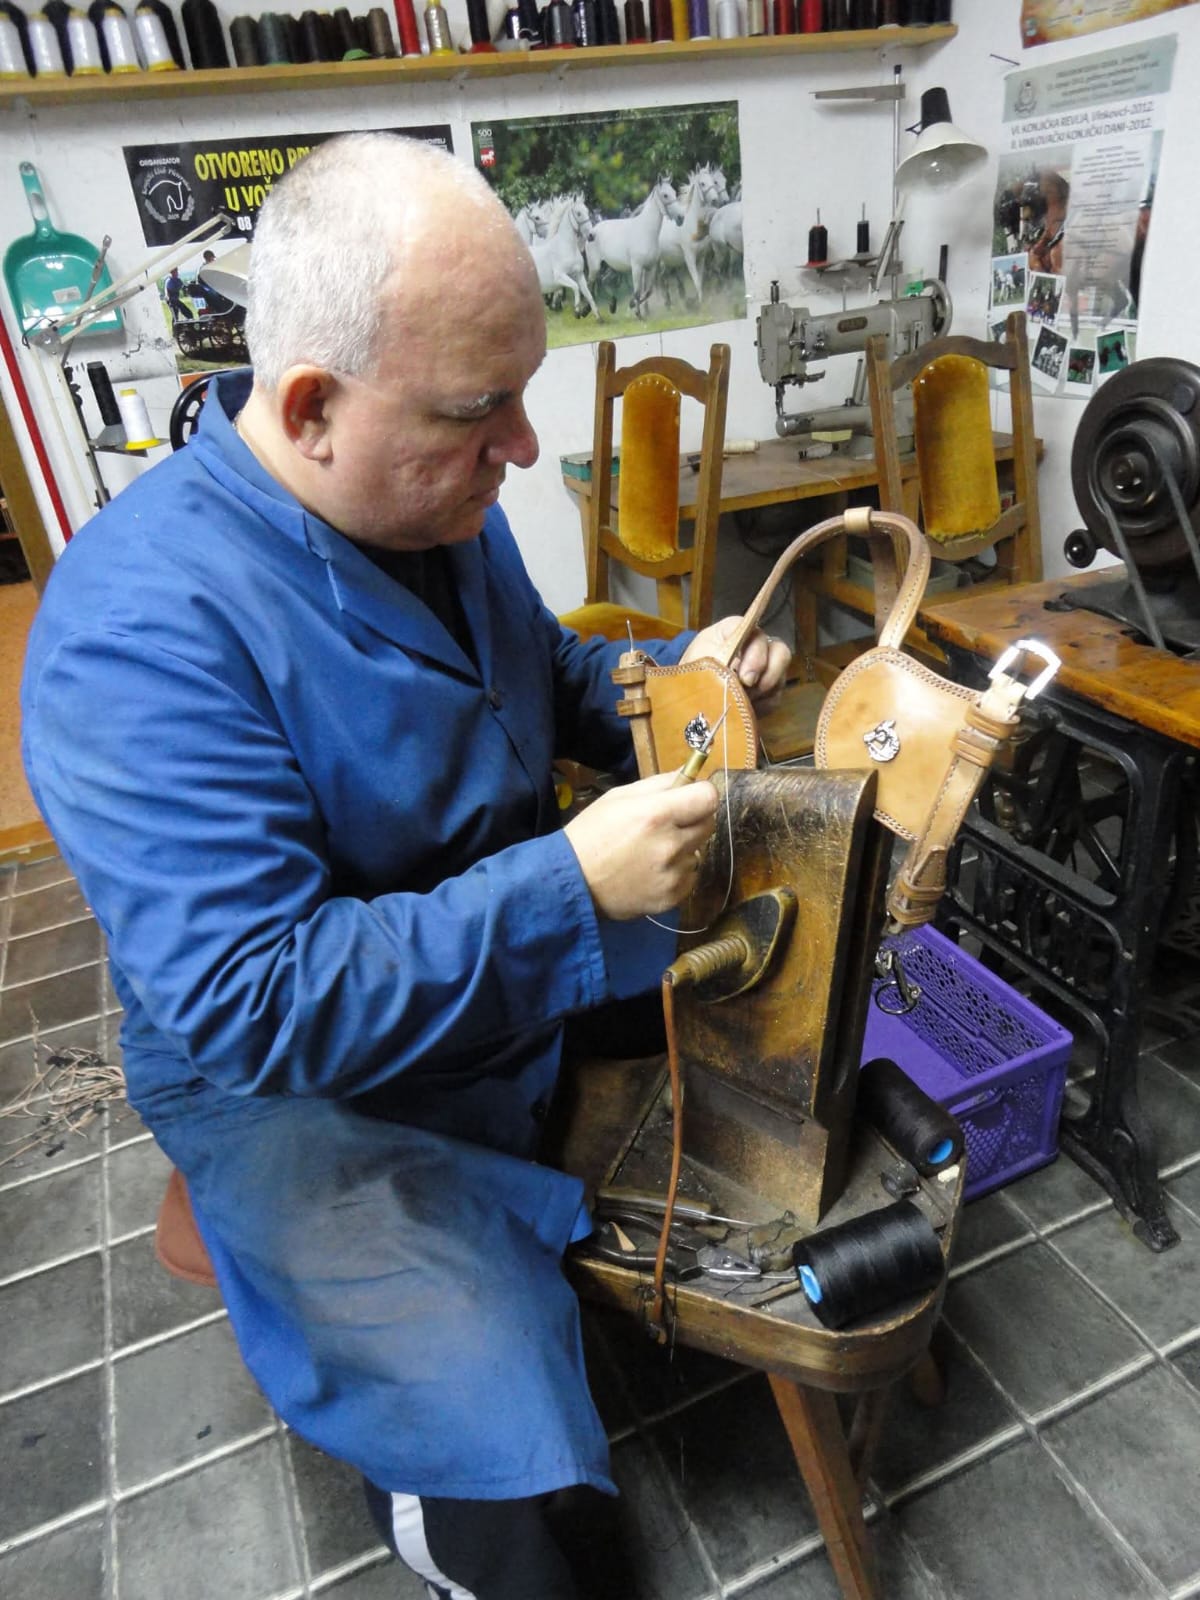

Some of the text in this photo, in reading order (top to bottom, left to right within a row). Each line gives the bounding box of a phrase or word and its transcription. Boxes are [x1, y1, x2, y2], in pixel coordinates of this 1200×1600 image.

[139, 157, 181, 167] ORGANIZATOR
[194, 148, 285, 181] OTVORENO
[224, 187, 240, 212] U
